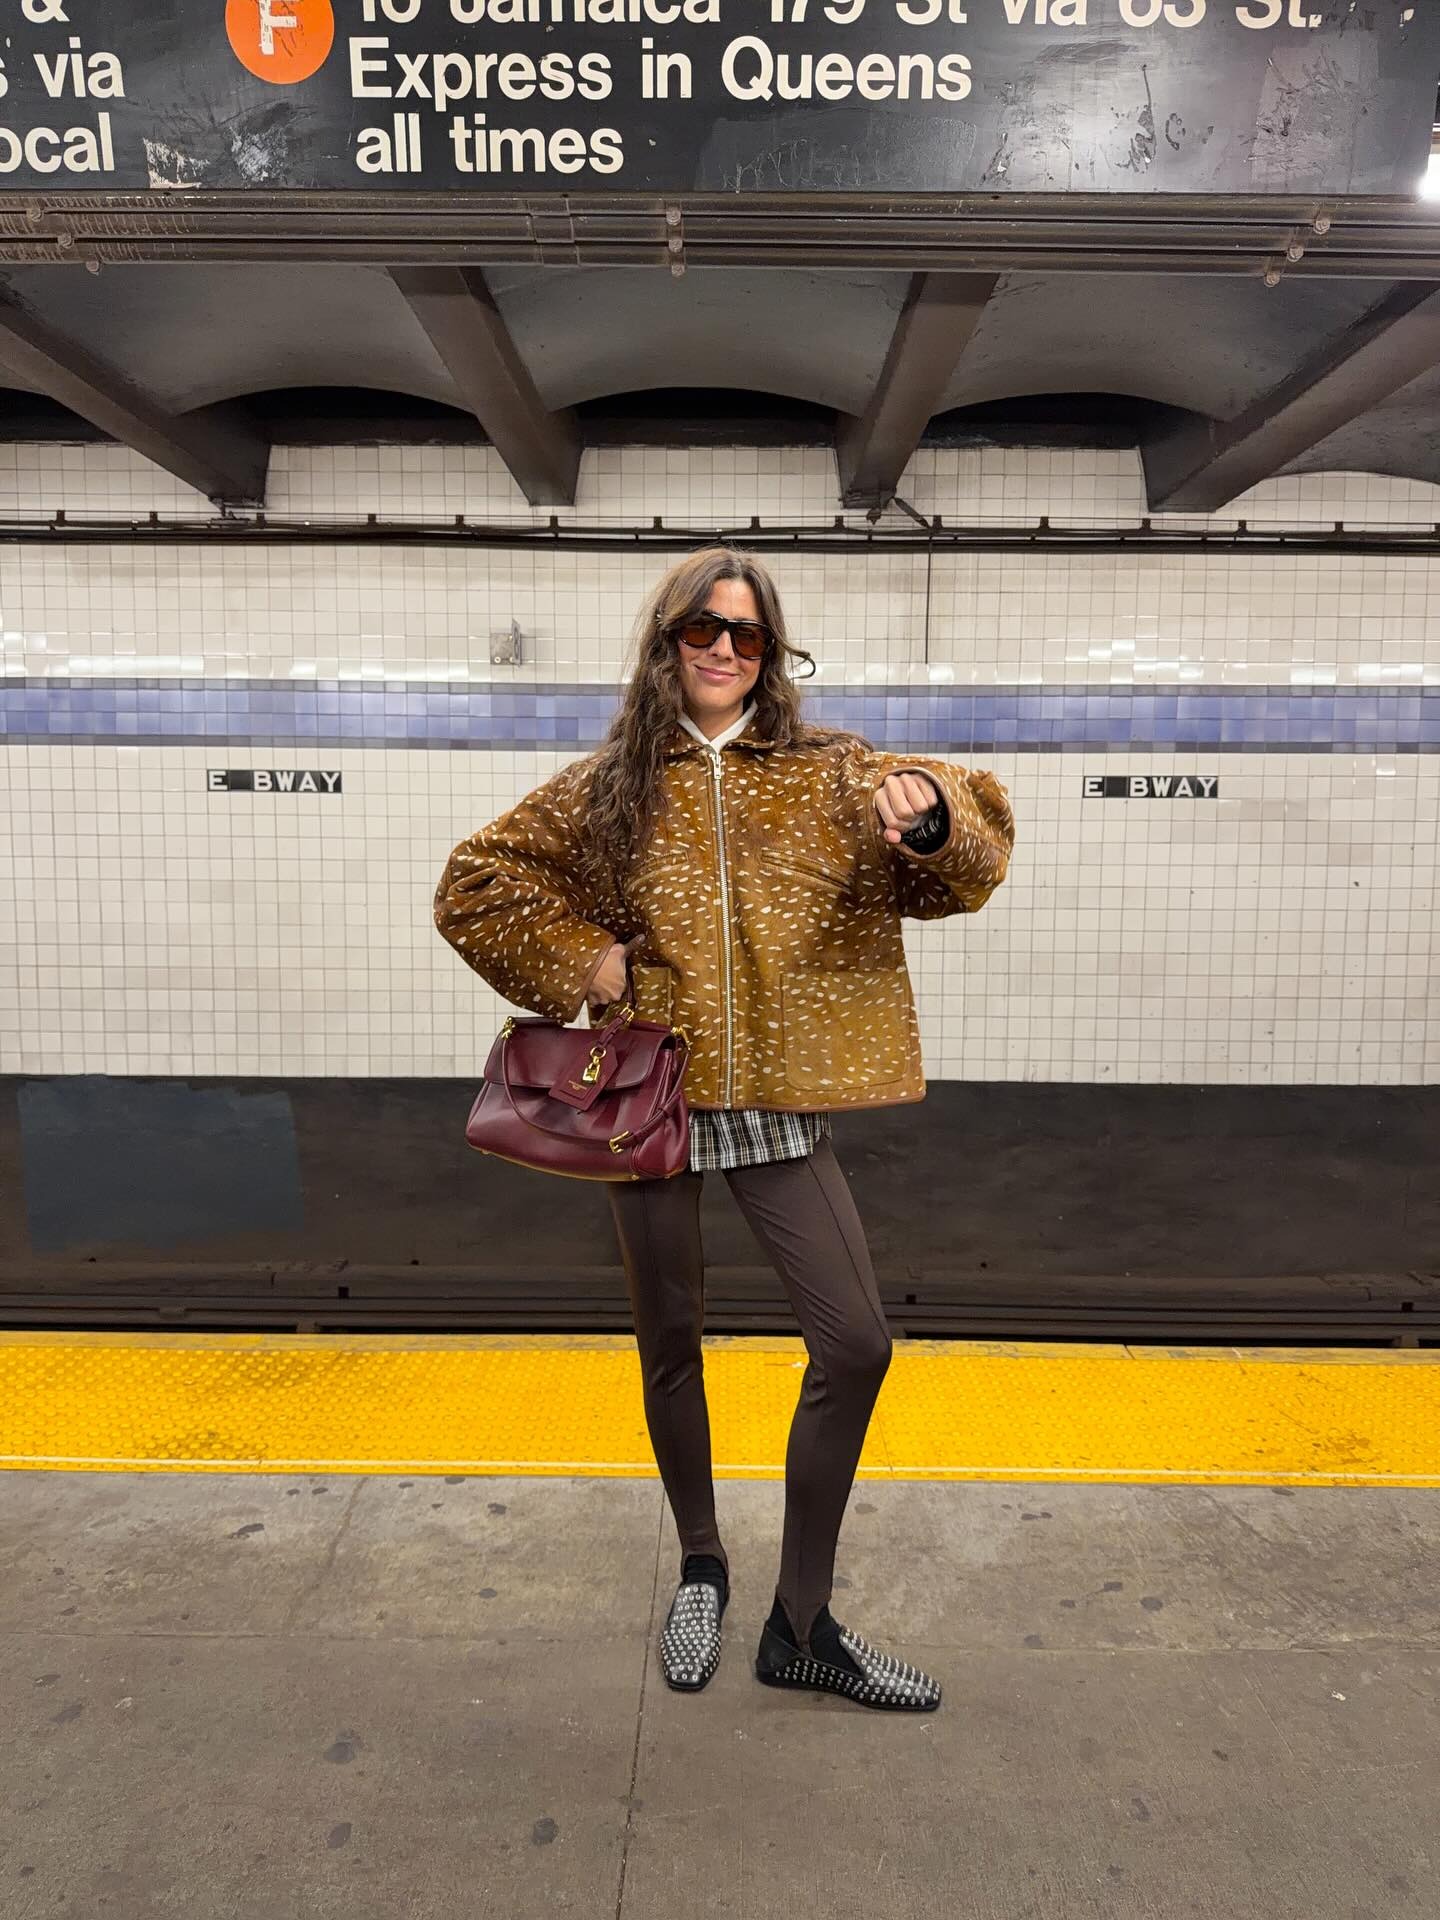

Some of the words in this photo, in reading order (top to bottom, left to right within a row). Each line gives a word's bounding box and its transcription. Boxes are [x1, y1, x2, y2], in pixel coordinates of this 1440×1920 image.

[33, 36, 126, 98] via
[349, 36, 613, 112] Express
[642, 37, 692, 99] in
[721, 35, 972, 101] Queens
[356, 112, 422, 173] all
[449, 113, 624, 174] times
[208, 770, 228, 791] E
[253, 771, 340, 793] BWAY
[1084, 776, 1103, 797] E
[1129, 776, 1217, 798] BWAY
